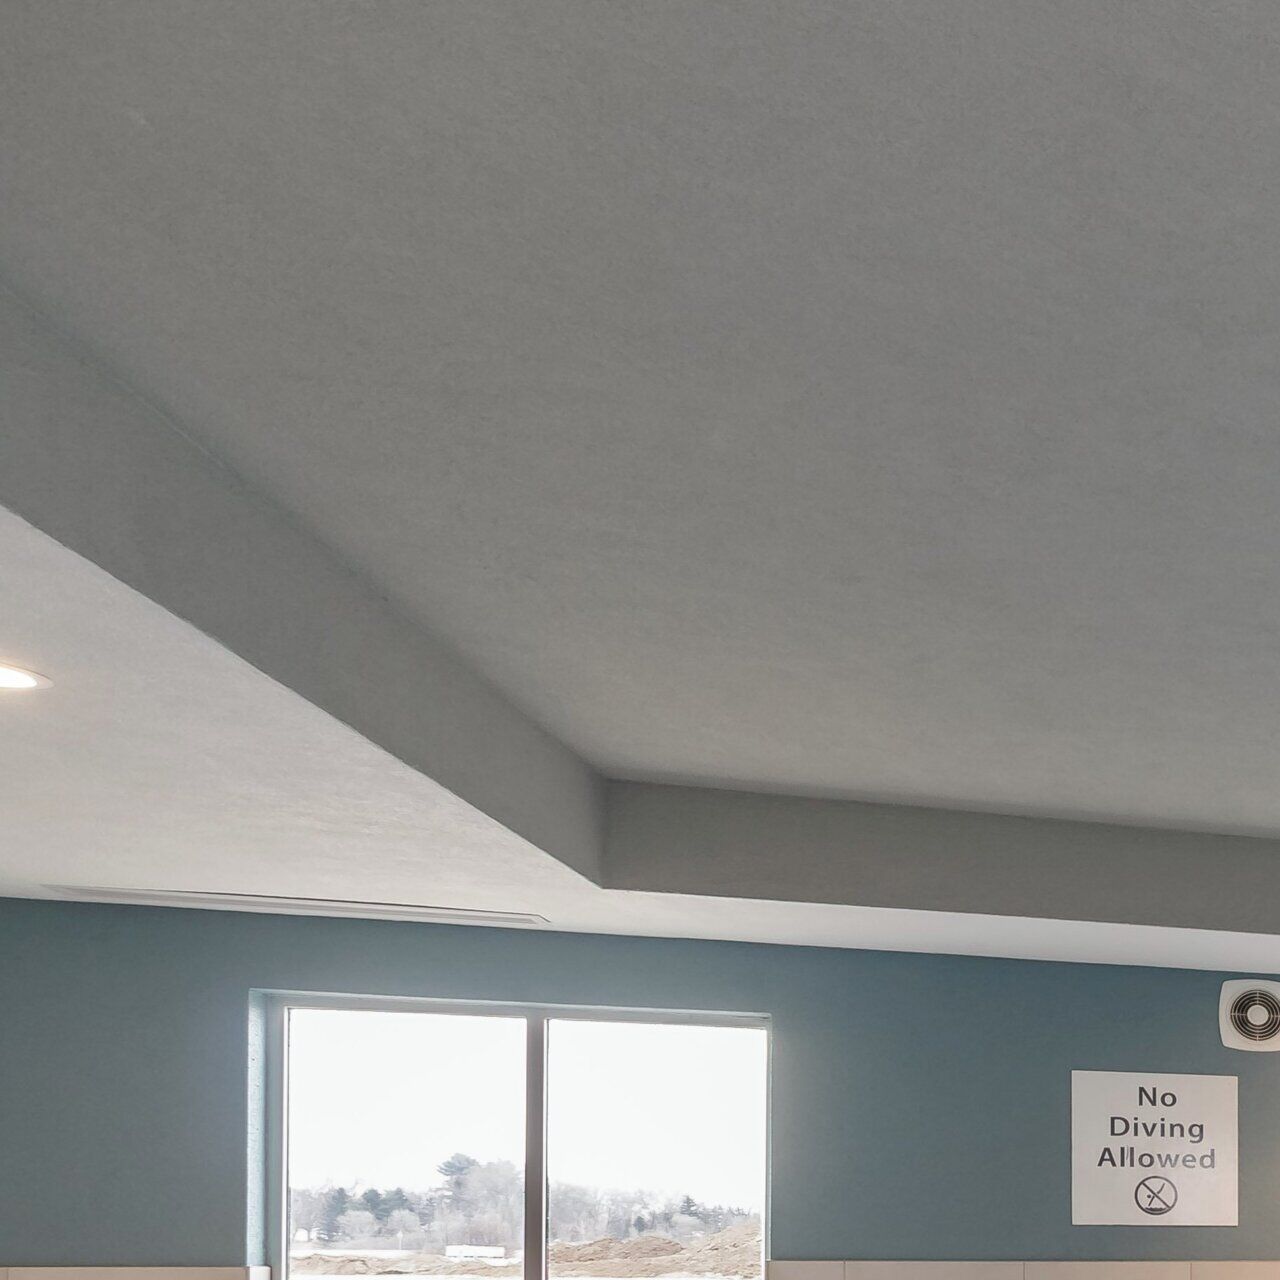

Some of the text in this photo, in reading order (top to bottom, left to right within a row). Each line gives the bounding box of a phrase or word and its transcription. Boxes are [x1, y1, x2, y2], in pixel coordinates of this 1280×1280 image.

[1138, 1086, 1177, 1107] No
[1110, 1116, 1204, 1144] Diving
[1097, 1147, 1216, 1169] Allowed
